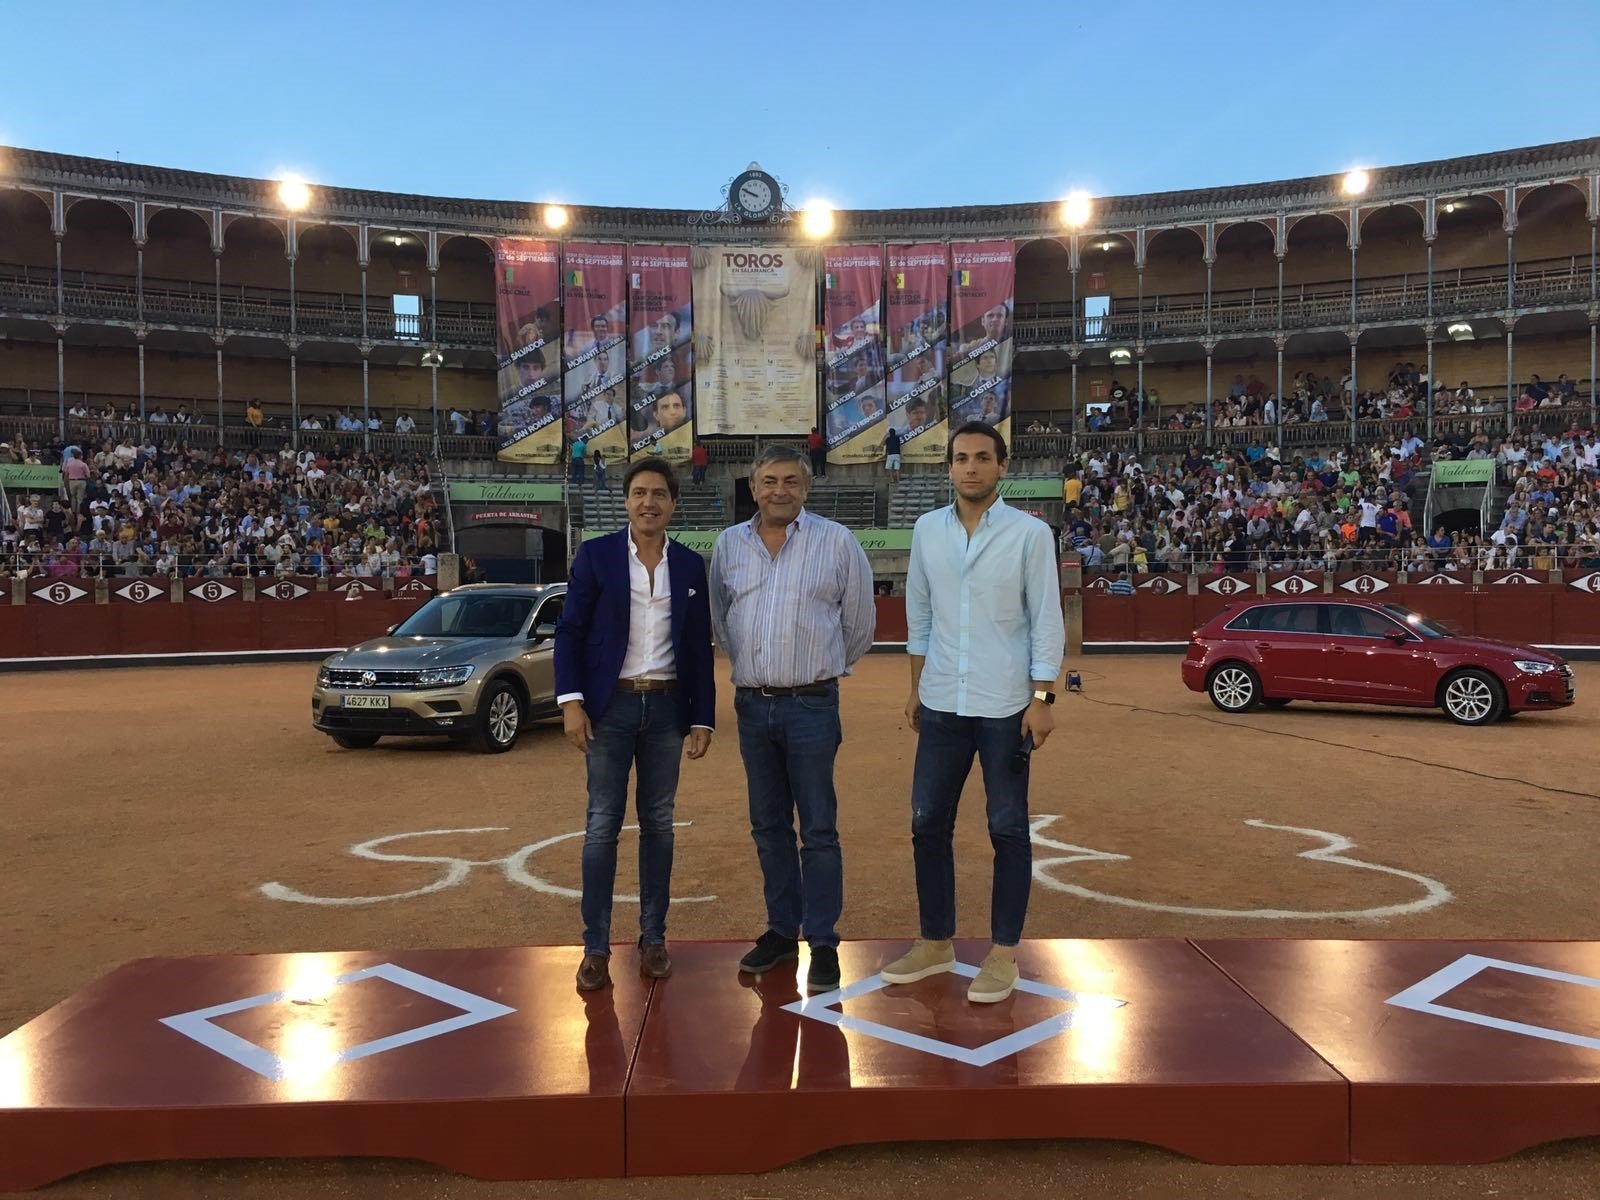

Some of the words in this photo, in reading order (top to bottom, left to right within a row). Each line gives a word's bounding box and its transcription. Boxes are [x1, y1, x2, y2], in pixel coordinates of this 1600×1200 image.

[722, 253, 784, 268] TOROS
[907, 258, 945, 266] SEPTIEMBRE
[972, 256, 1012, 264] SEPTIEMBRE
[510, 338, 546, 360] SALVADOR
[648, 345, 672, 362] PONCE
[968, 339, 998, 360] FERRERA
[566, 346, 600, 369] MORANTE
[518, 378, 548, 396] GRANDE
[581, 374, 624, 402] MANZANARES
[910, 378, 936, 397] CHAVES
[970, 376, 1002, 398] CASTELLA
[633, 402, 642, 411] EL
[642, 394, 656, 406] JULI
[513, 428, 528, 440] SAN
[652, 428, 666, 440] REY
[904, 425, 924, 442] DAVID
[4, 468, 54, 481] Valduero
[1442, 464, 1488, 476] Valduero
[479, 485, 535, 500] Valduero
[134, 585, 145, 599] 5
[208, 584, 218, 598] 5
[281, 584, 290, 598] 5
[1222, 580, 1232, 594] 4
[1288, 580, 1298, 593] 4
[1360, 578, 1370, 592] 4
[55, 586, 66, 600] 5
[346, 696, 368, 706] 4627
[370, 697, 387, 707] KKX
